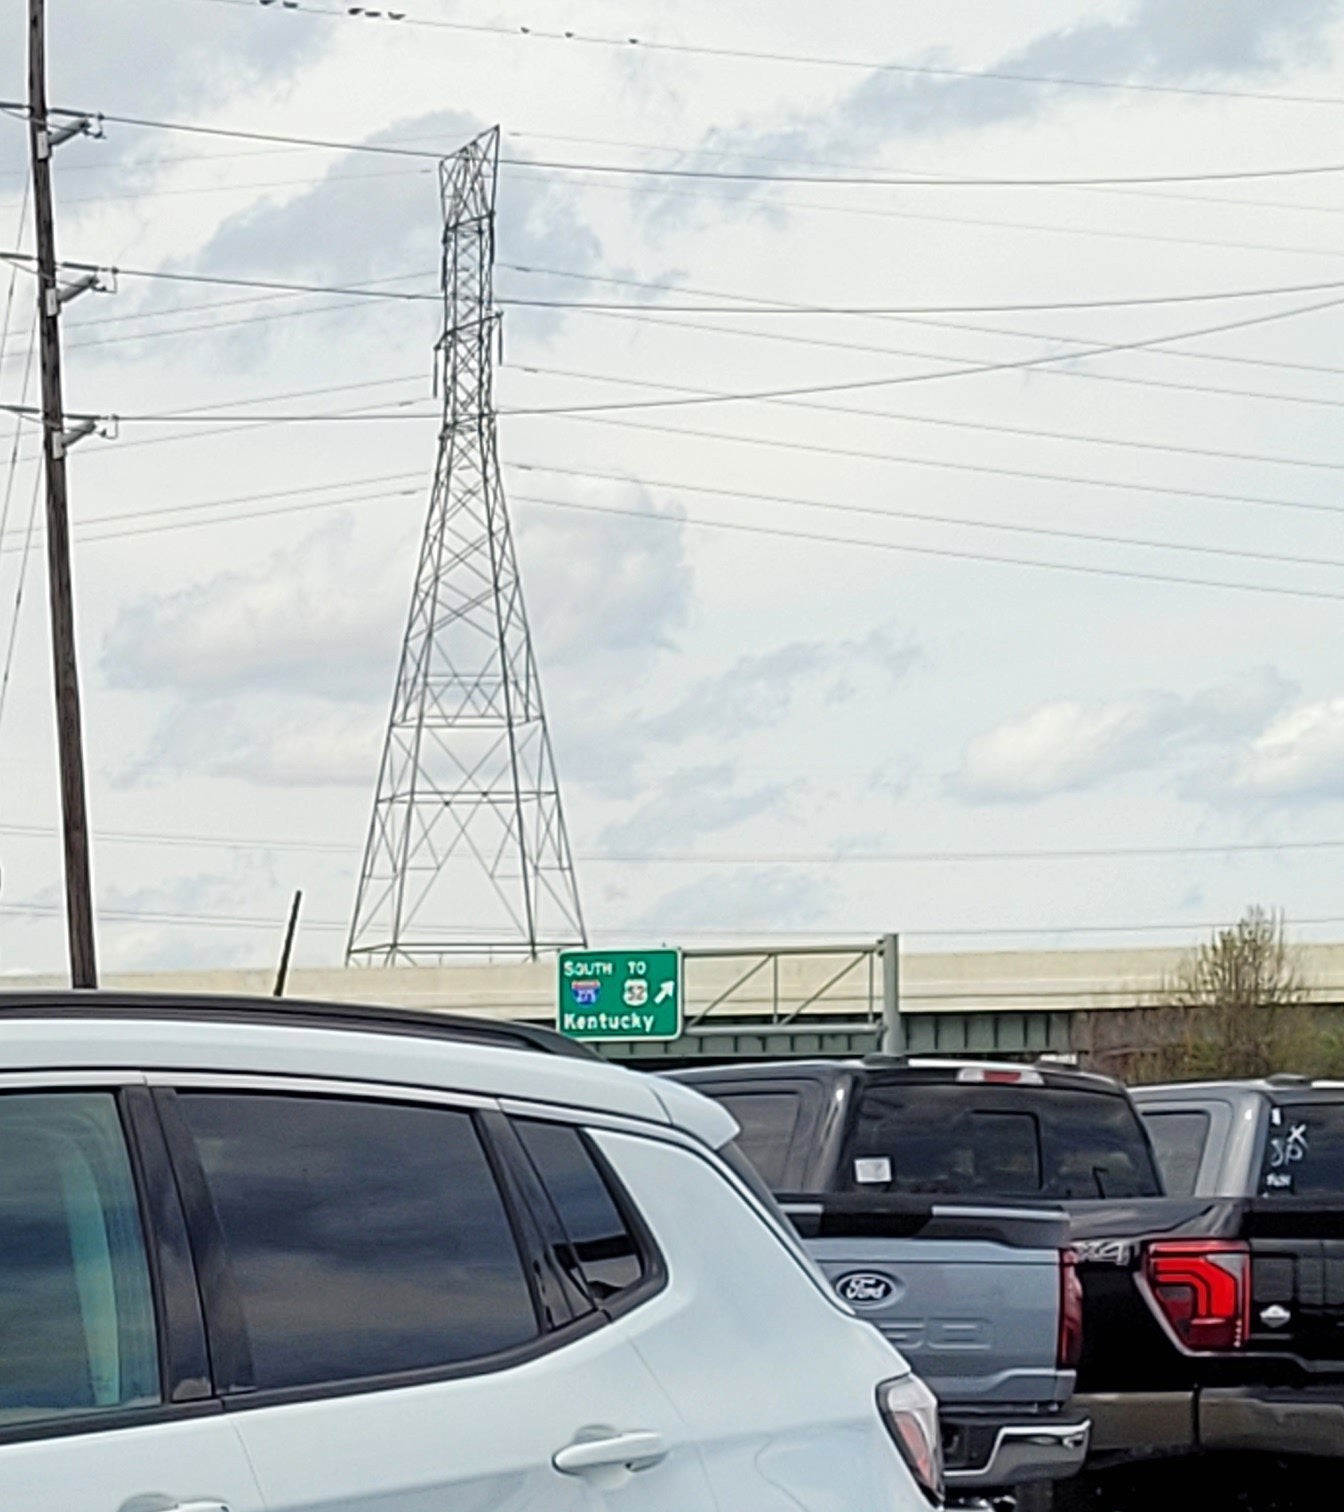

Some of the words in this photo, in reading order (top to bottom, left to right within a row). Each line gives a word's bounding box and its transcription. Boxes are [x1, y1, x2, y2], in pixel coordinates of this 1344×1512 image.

[563, 961, 612, 976] SOUTH
[628, 961, 646, 975] TO
[563, 1013, 654, 1033] Kentucky
[846, 1278, 886, 1300] Ford
